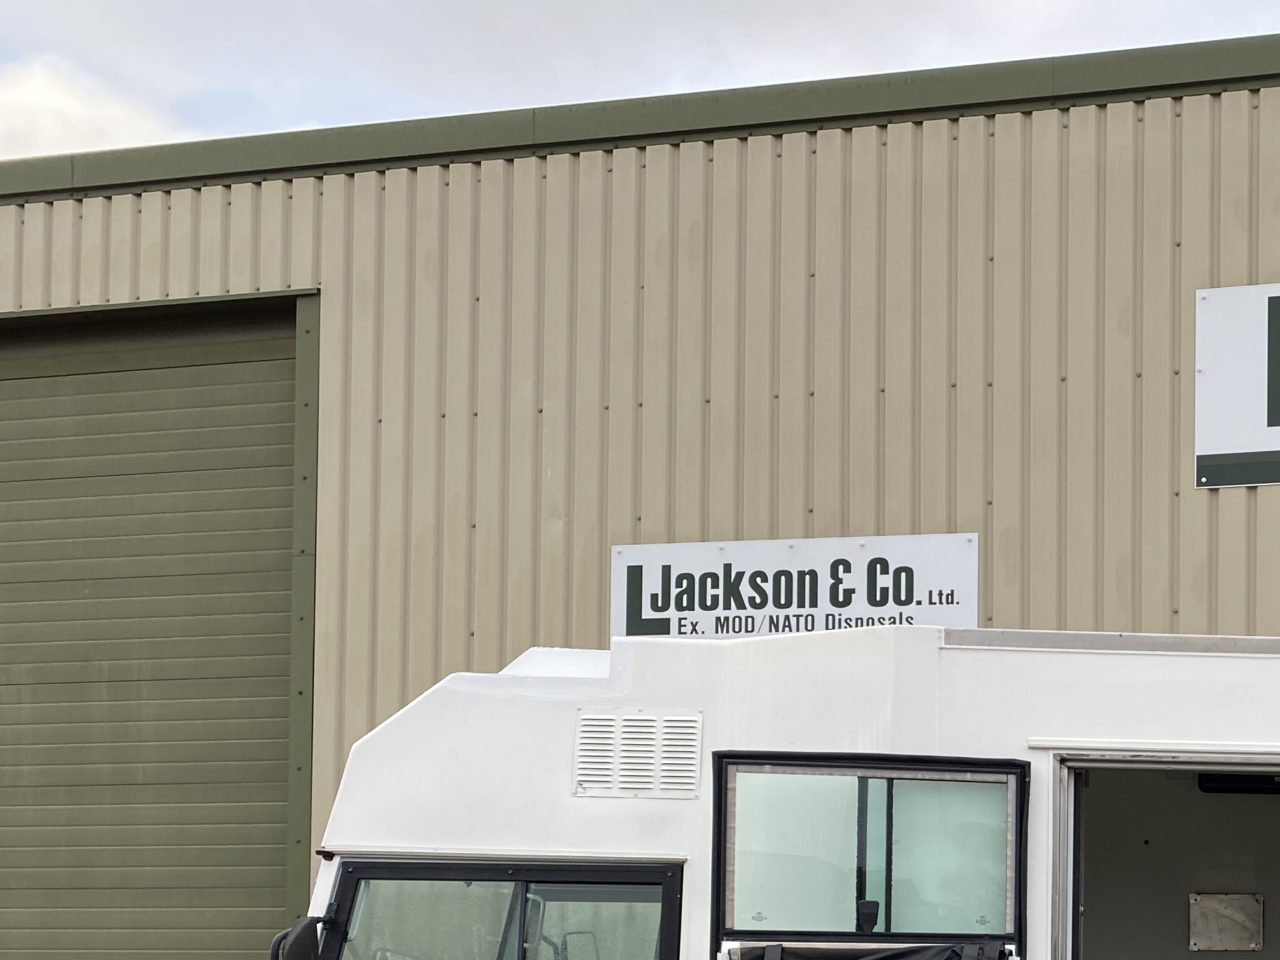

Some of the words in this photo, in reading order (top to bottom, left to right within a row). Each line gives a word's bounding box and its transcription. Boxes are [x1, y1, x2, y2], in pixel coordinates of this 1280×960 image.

[829, 558, 856, 609] &
[866, 556, 923, 608] Co.
[928, 589, 960, 606] Ltd.
[677, 616, 705, 636] Ex.
[714, 613, 816, 635] MOD/NATO
